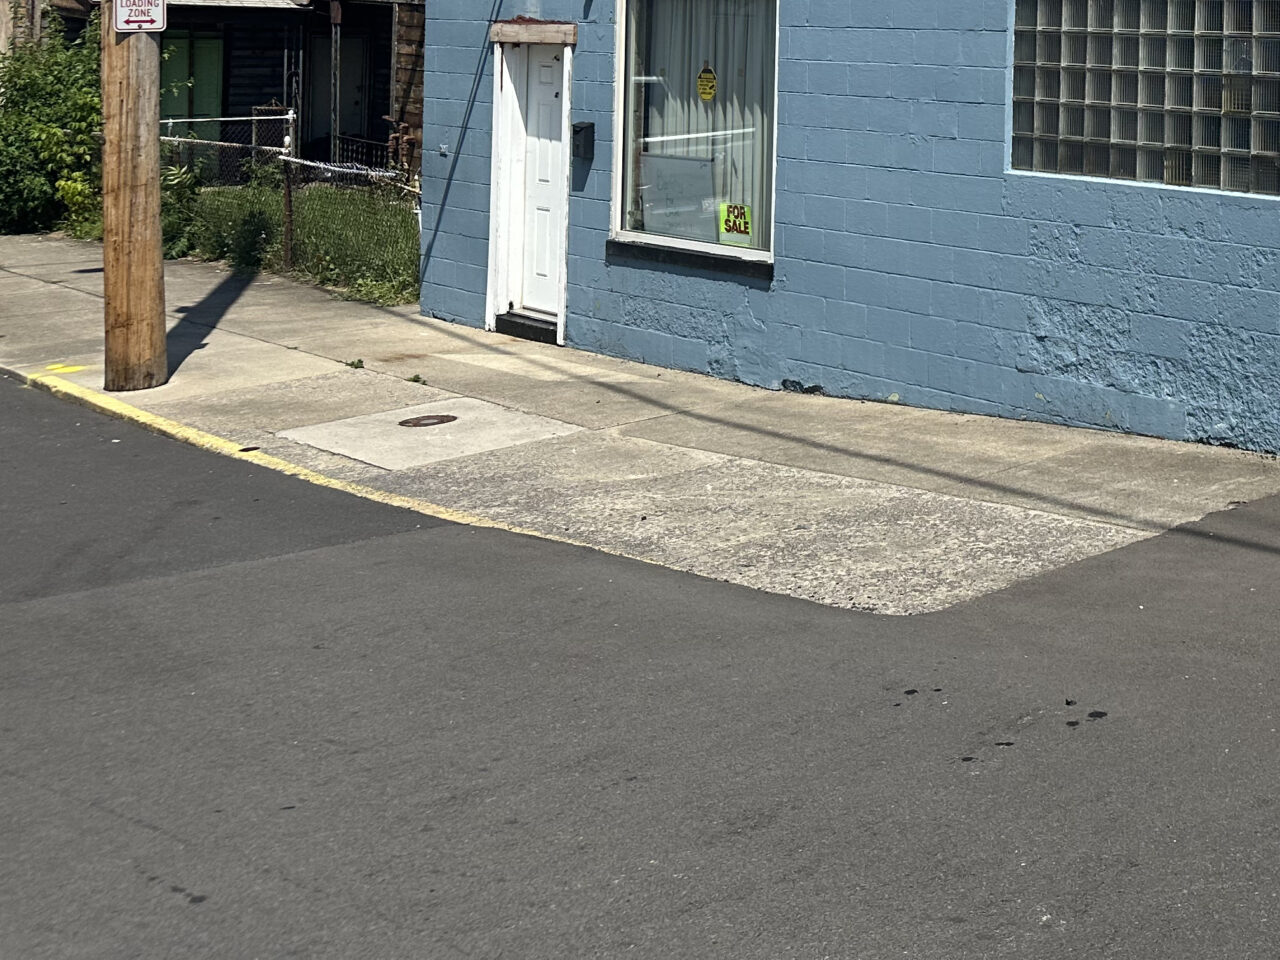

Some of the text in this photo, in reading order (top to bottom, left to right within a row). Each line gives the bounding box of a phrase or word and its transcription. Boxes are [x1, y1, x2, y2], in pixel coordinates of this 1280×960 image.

[120, 0, 160, 8] LOADING
[128, 8, 152, 18] ZONE
[727, 204, 747, 221] FOR
[724, 218, 750, 235] SALE
